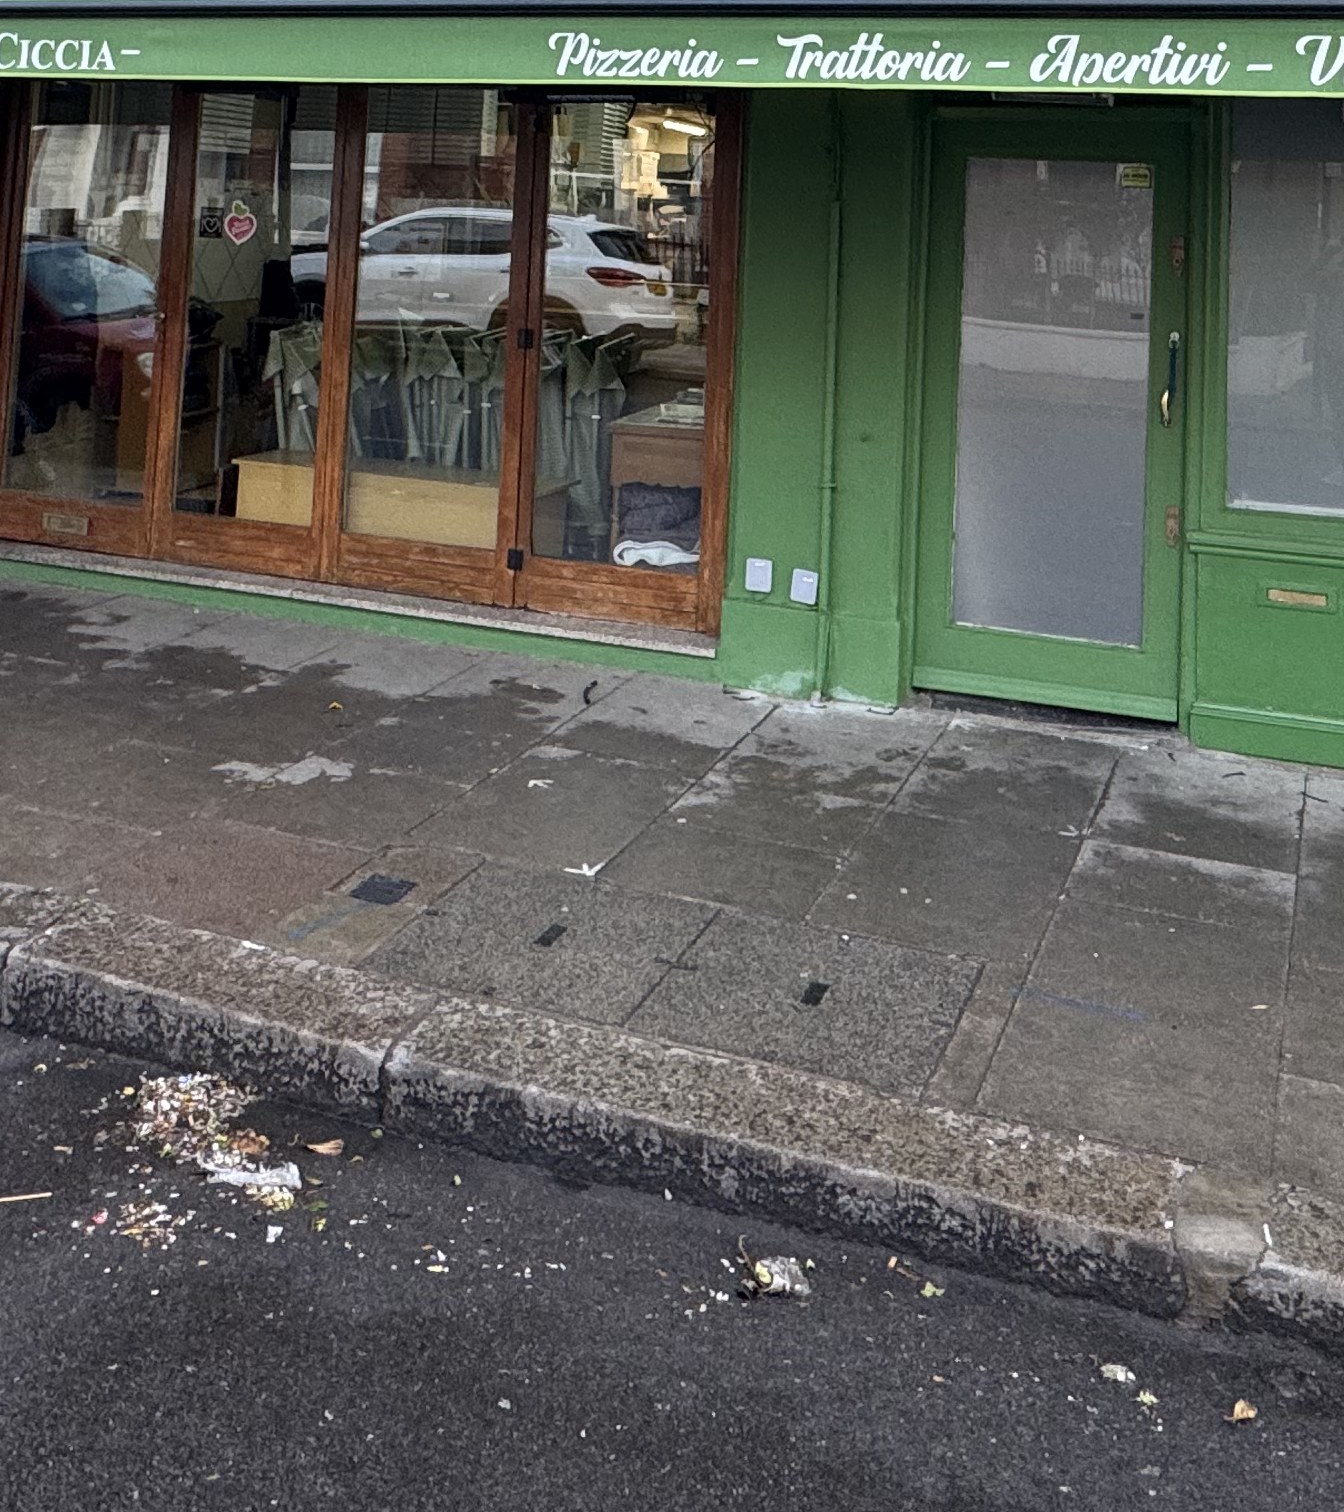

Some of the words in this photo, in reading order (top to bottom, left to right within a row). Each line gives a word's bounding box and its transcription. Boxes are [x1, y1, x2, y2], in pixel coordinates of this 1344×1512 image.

[548, 31, 724, 78] Pizzeria
[777, 32, 971, 82] Trattoria
[1029, 34, 1231, 87] Apertivi
